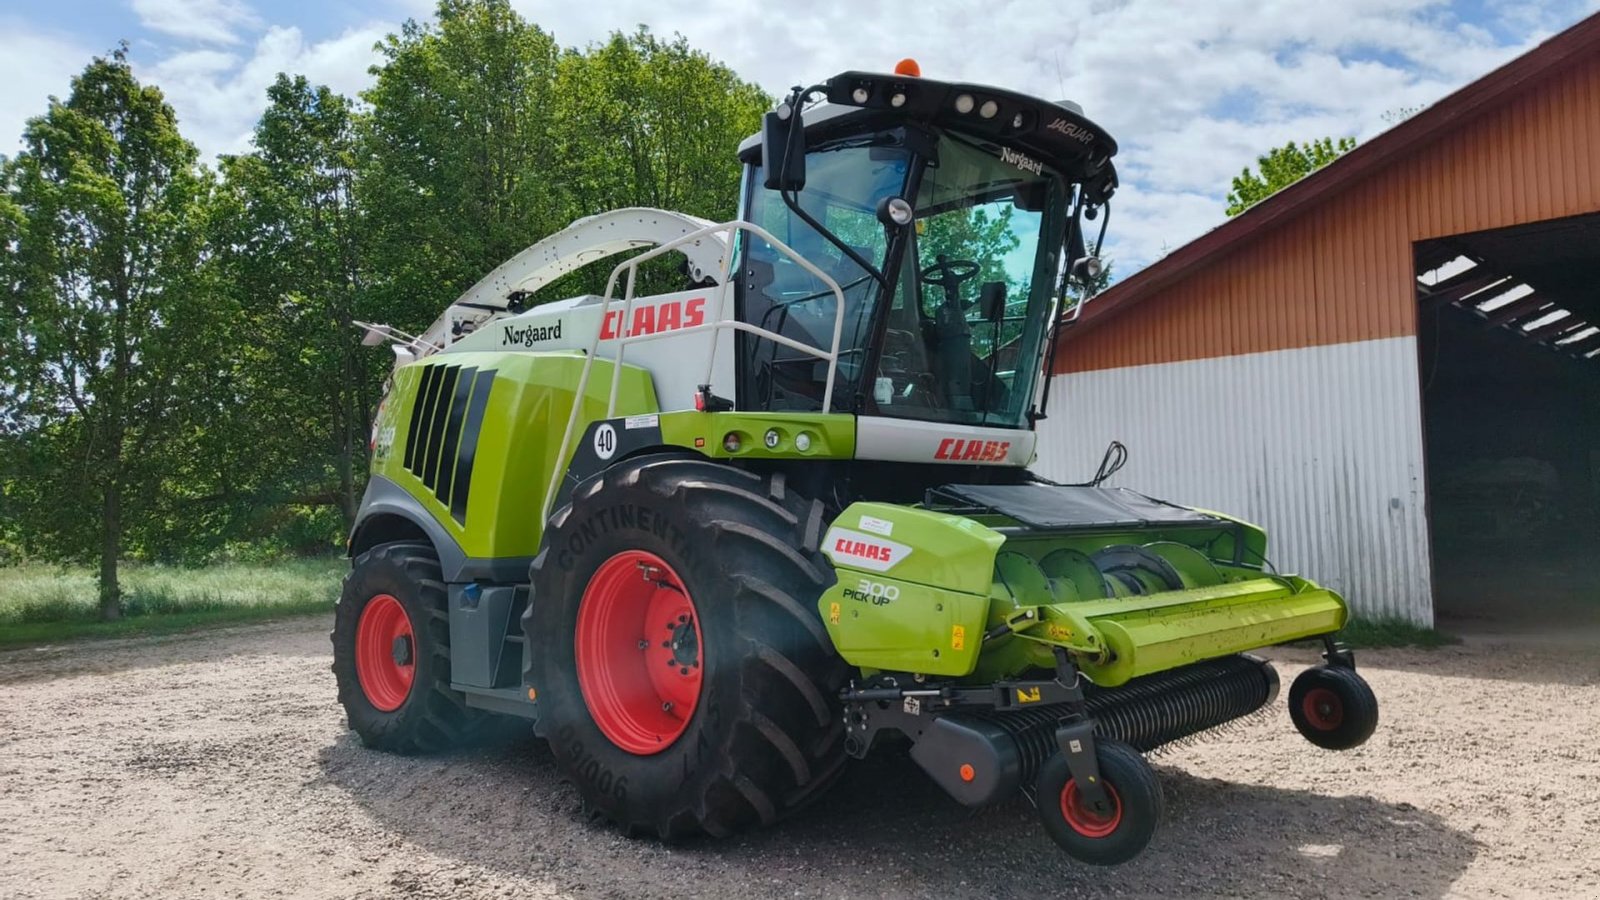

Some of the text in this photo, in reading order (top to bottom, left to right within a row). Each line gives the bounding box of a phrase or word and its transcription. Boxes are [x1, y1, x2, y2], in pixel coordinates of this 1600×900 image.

[1046, 118, 1094, 144] JAGUAR
[599, 298, 705, 340] CLAAS
[503, 319, 562, 347] Nørgaard
[598, 430, 612, 452] 40
[934, 438, 1010, 461] CLAAS
[835, 539, 891, 562] CLAAS
[842, 588, 890, 606] PICK UP
[858, 580, 900, 601] 300
